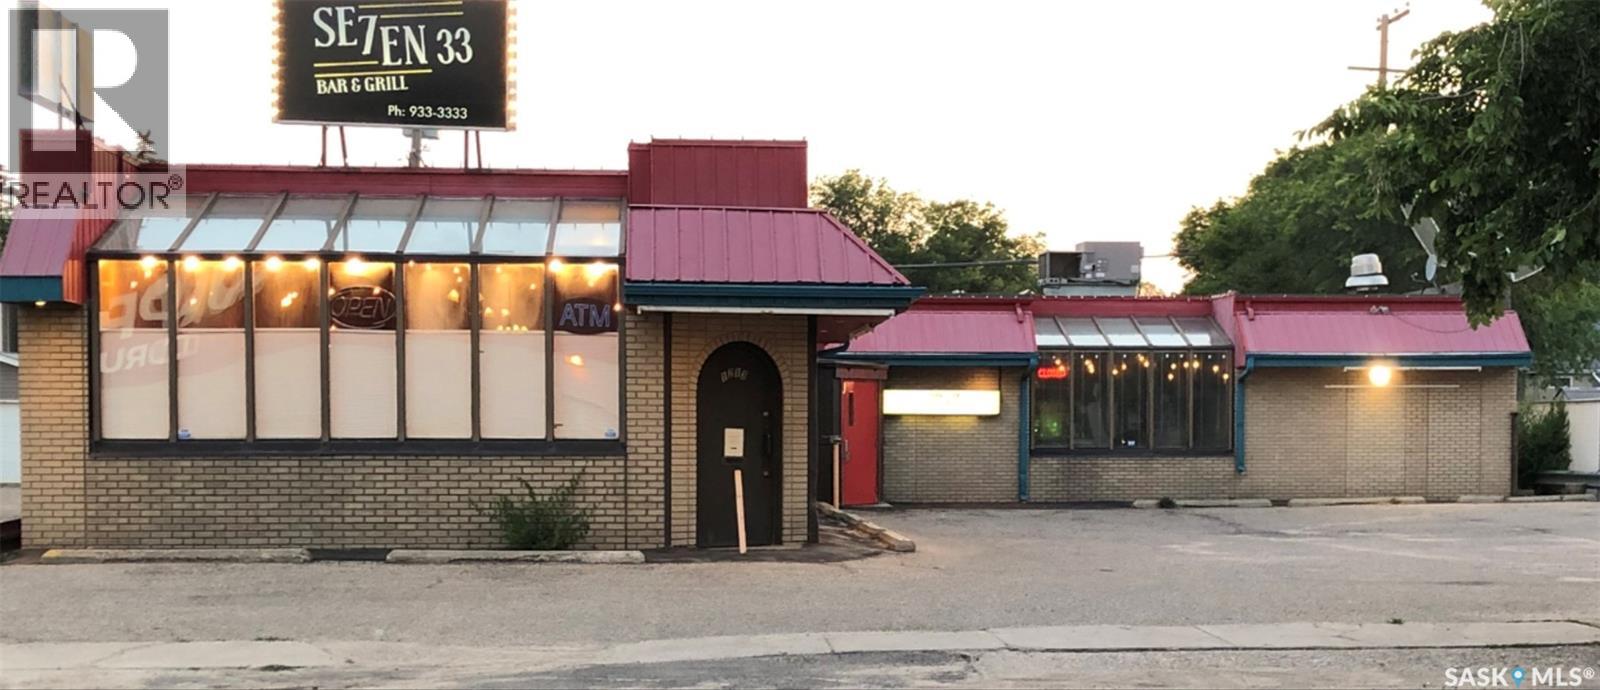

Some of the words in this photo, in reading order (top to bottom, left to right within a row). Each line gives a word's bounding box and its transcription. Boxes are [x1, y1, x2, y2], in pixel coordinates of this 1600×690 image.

[313, 6, 428, 66] SE7EN
[436, 27, 473, 64] 33
[316, 79, 348, 94] BAR
[351, 78, 360, 92] &
[364, 76, 408, 91] GRILL
[387, 105, 406, 117] Ph:
[409, 105, 468, 119] 933-3333
[331, 296, 392, 320] OPEN
[560, 302, 611, 328] ATM
